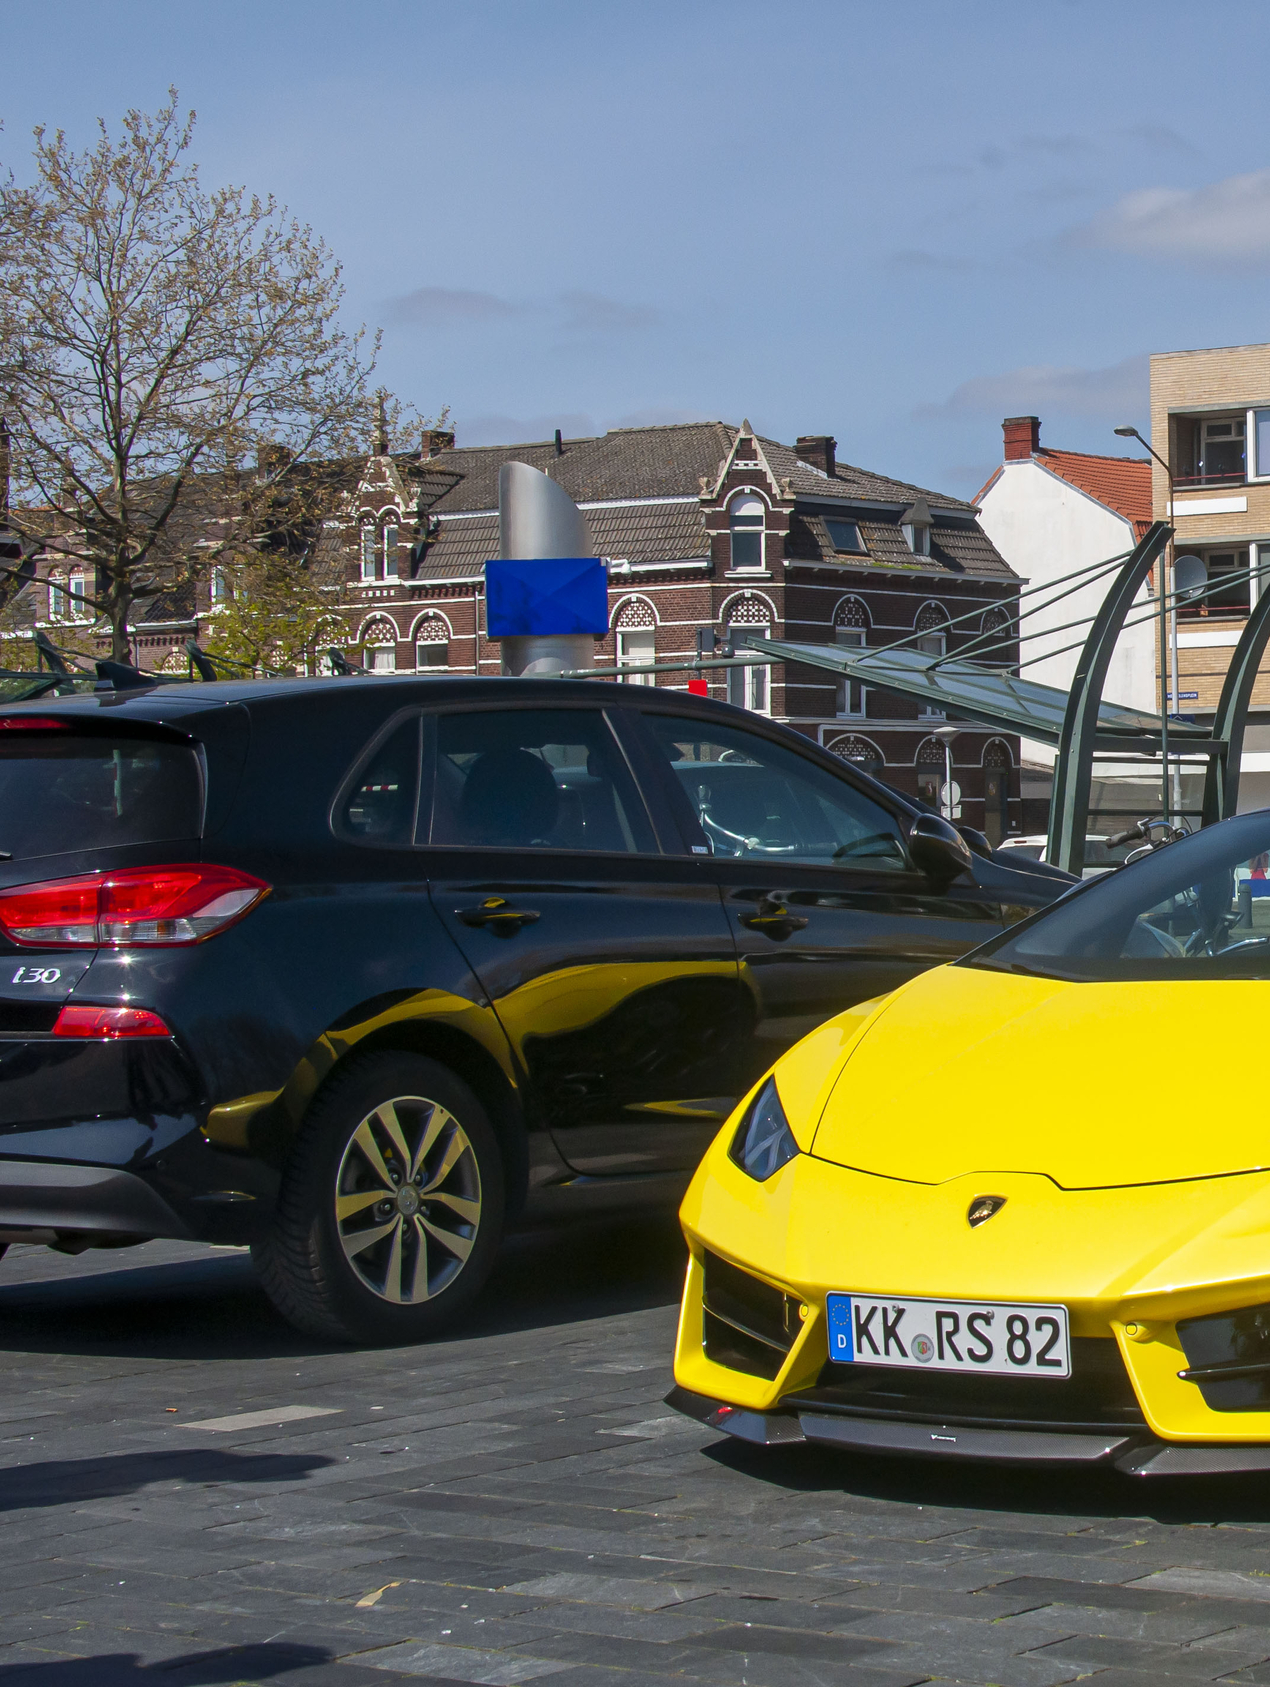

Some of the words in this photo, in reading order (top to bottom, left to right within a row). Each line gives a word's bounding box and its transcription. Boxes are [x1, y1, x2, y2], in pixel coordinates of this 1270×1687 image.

[11, 966, 61, 984] i30
[837, 1333, 847, 1349] D
[854, 1303, 910, 1359] KK
[935, 1310, 994, 1364] RS
[1006, 1313, 1063, 1368] 82
